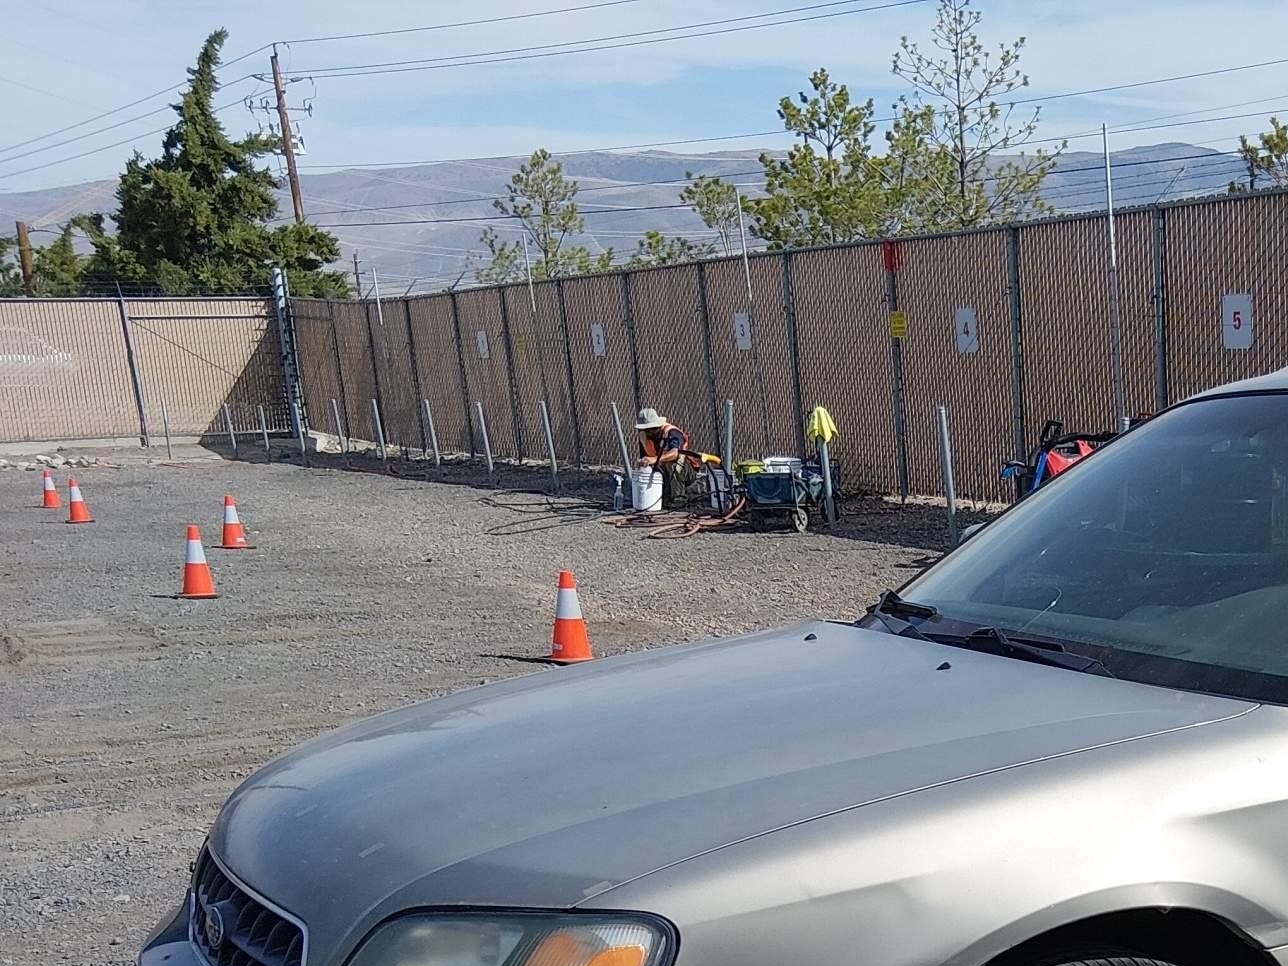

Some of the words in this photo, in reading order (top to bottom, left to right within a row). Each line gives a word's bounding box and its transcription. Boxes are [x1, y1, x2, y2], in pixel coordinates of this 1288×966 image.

[1232, 310, 1242, 330] 5
[740, 324, 746, 337] 3
[963, 322, 970, 337] 4
